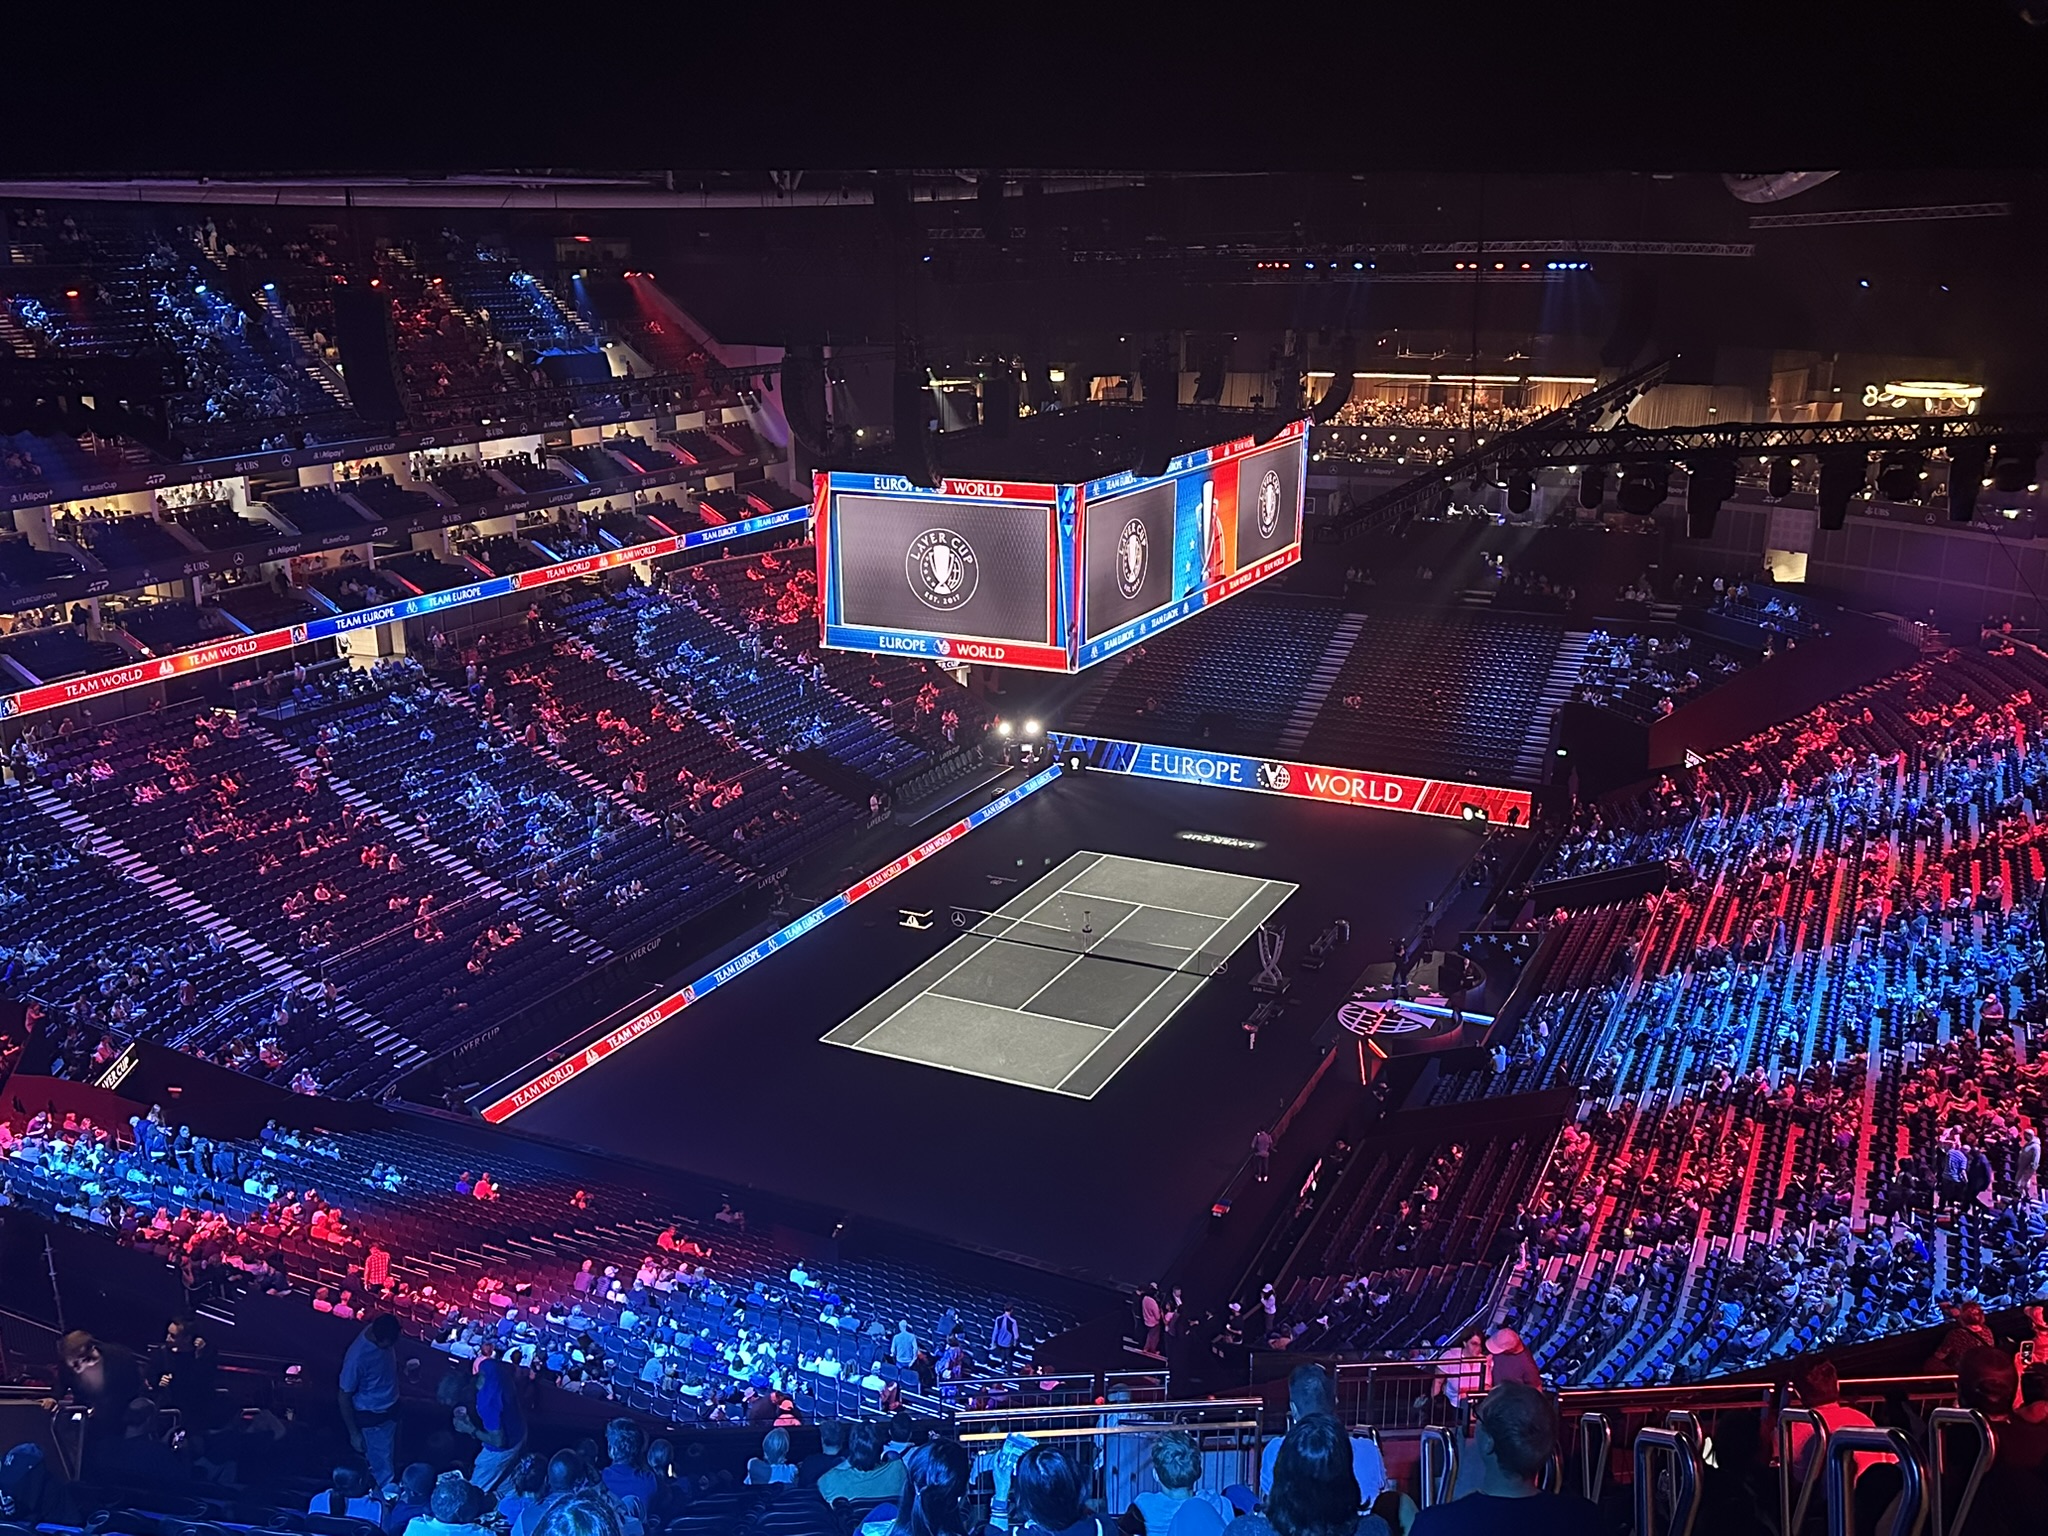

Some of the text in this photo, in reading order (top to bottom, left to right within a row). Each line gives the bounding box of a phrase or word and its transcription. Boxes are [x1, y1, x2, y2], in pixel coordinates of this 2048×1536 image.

[491, 427, 504, 436] UBS
[383, 443, 396, 451] CUP
[243, 461, 259, 471] UBS
[146, 474, 166, 485] ATP
[191, 473, 213, 482] ROLEX
[82, 482, 117, 493] #LaverCup
[953, 482, 1003, 497] WORLD
[449, 514, 462, 522] UBS
[757, 512, 790, 528] TEAM EUROPE
[1874, 508, 1890, 516] UBS
[322, 534, 350, 545] #LaverCup
[371, 527, 388, 537] ATP
[702, 524, 738, 541] TEAM EUROPE
[616, 545, 656, 561] TEAM WORLD
[910, 532, 973, 564] LAVER CUP
[192, 560, 210, 572] UBS
[546, 560, 591, 580] TEAM WORLD
[86, 580, 109, 592] ATP
[428, 585, 482, 608] TEAM EUROPE
[924, 591, 961, 604] EST. 2017
[335, 606, 395, 630] TEAM EUROPE
[1151, 608, 1178, 628] TEAM EUROPE
[879, 636, 926, 652] EUROPE
[1104, 629, 1134, 650] TEAM EUROPE
[188, 640, 258, 666] TEAM WORLD
[956, 644, 1005, 660] WORLD
[64, 668, 143, 698] TEAM WORLD
[1150, 752, 1242, 784] EUROPE
[1304, 772, 1404, 803] WORLD
[881, 809, 892, 822] CUP
[982, 806, 995, 818] TEAM
[919, 832, 952, 857] TEAM WORLD
[758, 868, 788, 890] LAVER CUP
[866, 862, 902, 889] TEAM WORLD
[784, 910, 826, 940] TEAM EUROPE
[624, 938, 662, 964] LAVER CUP
[714, 949, 762, 984] TEAM EUROPE
[606, 1010, 662, 1049] TEAM WORLD
[452, 1026, 500, 1058] LAVER CUP
[116, 1056, 130, 1076] CUP
[512, 1064, 574, 1108] TEAM WORLD
